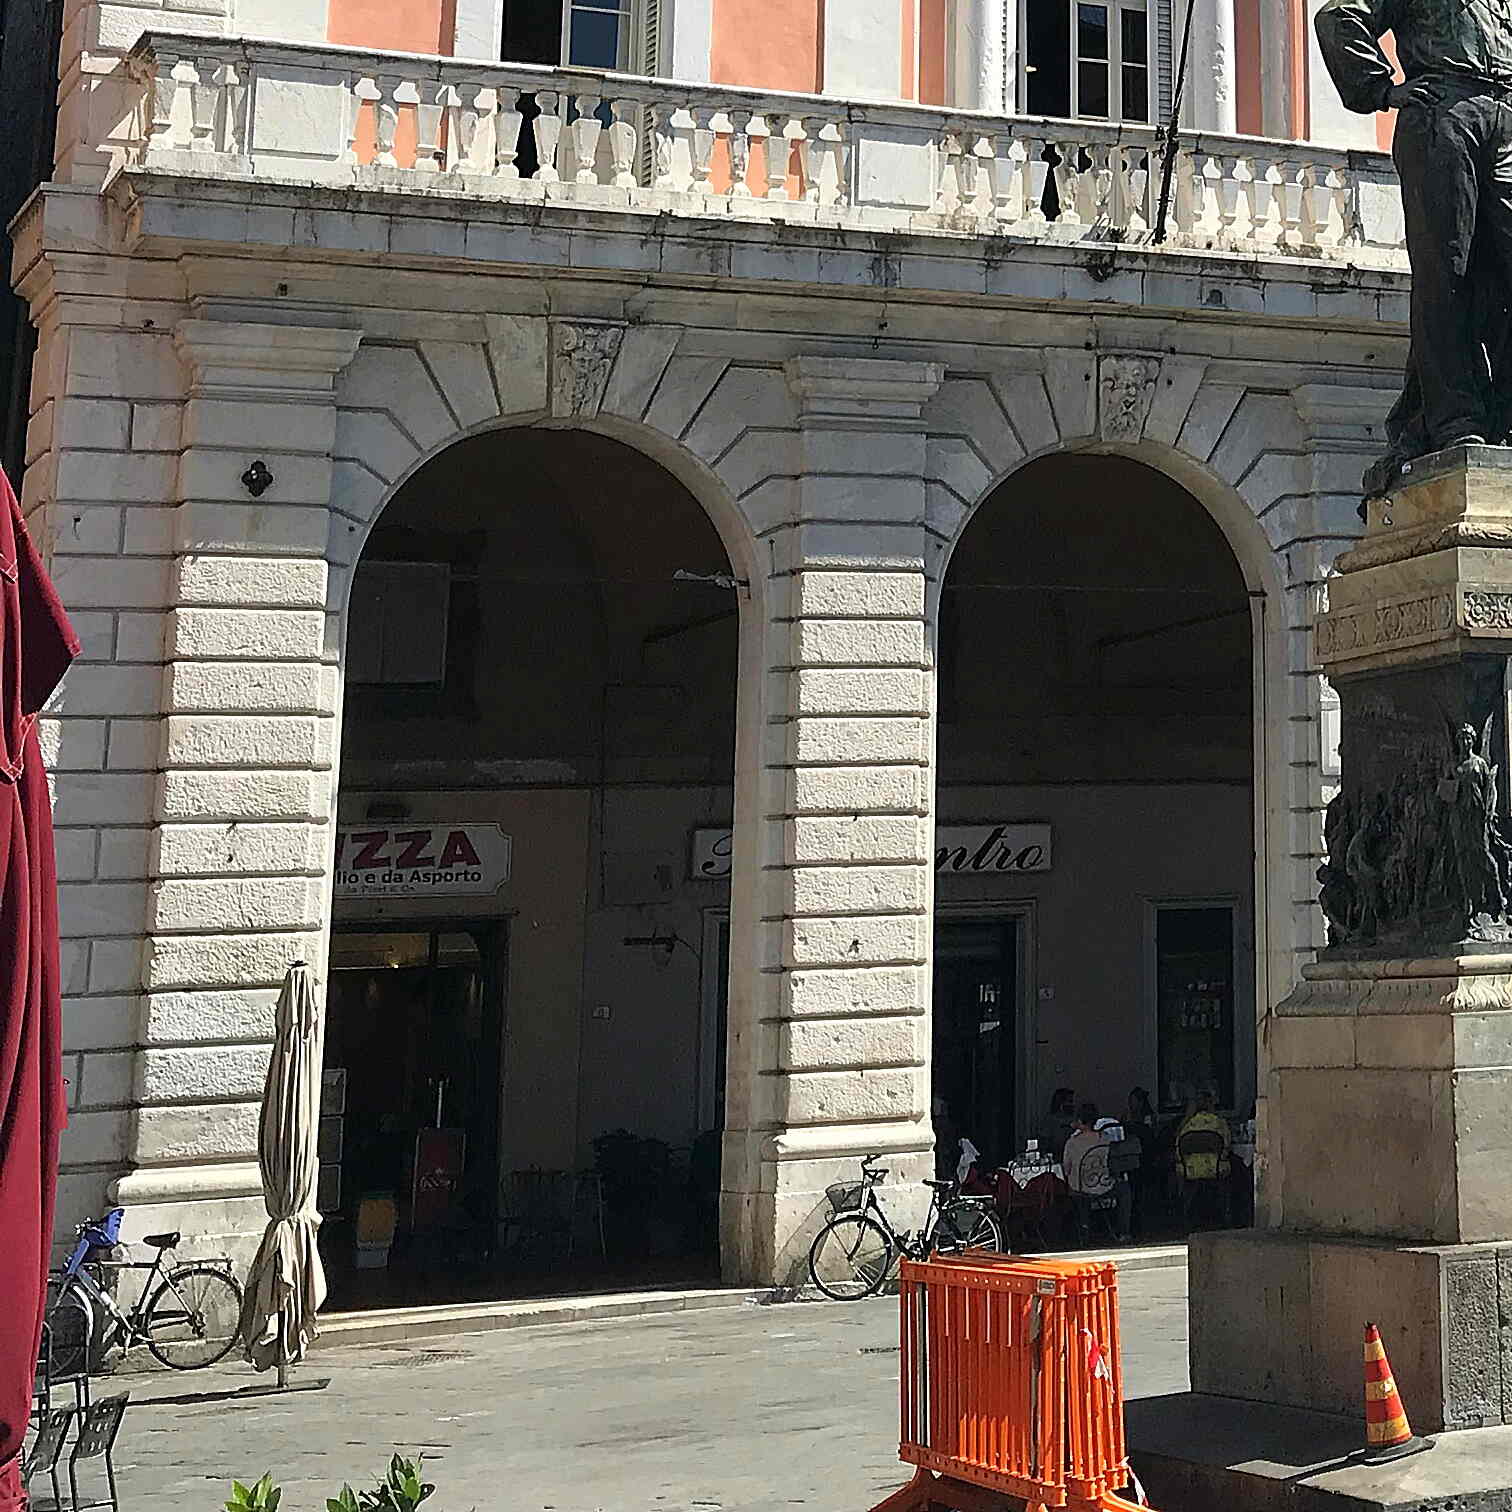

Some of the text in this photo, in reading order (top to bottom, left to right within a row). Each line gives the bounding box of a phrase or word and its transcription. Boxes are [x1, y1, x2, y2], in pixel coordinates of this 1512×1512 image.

[335, 830, 482, 870] IZZA
[935, 825, 1045, 872] ntro
[336, 869, 482, 886] lio e da Asporto
